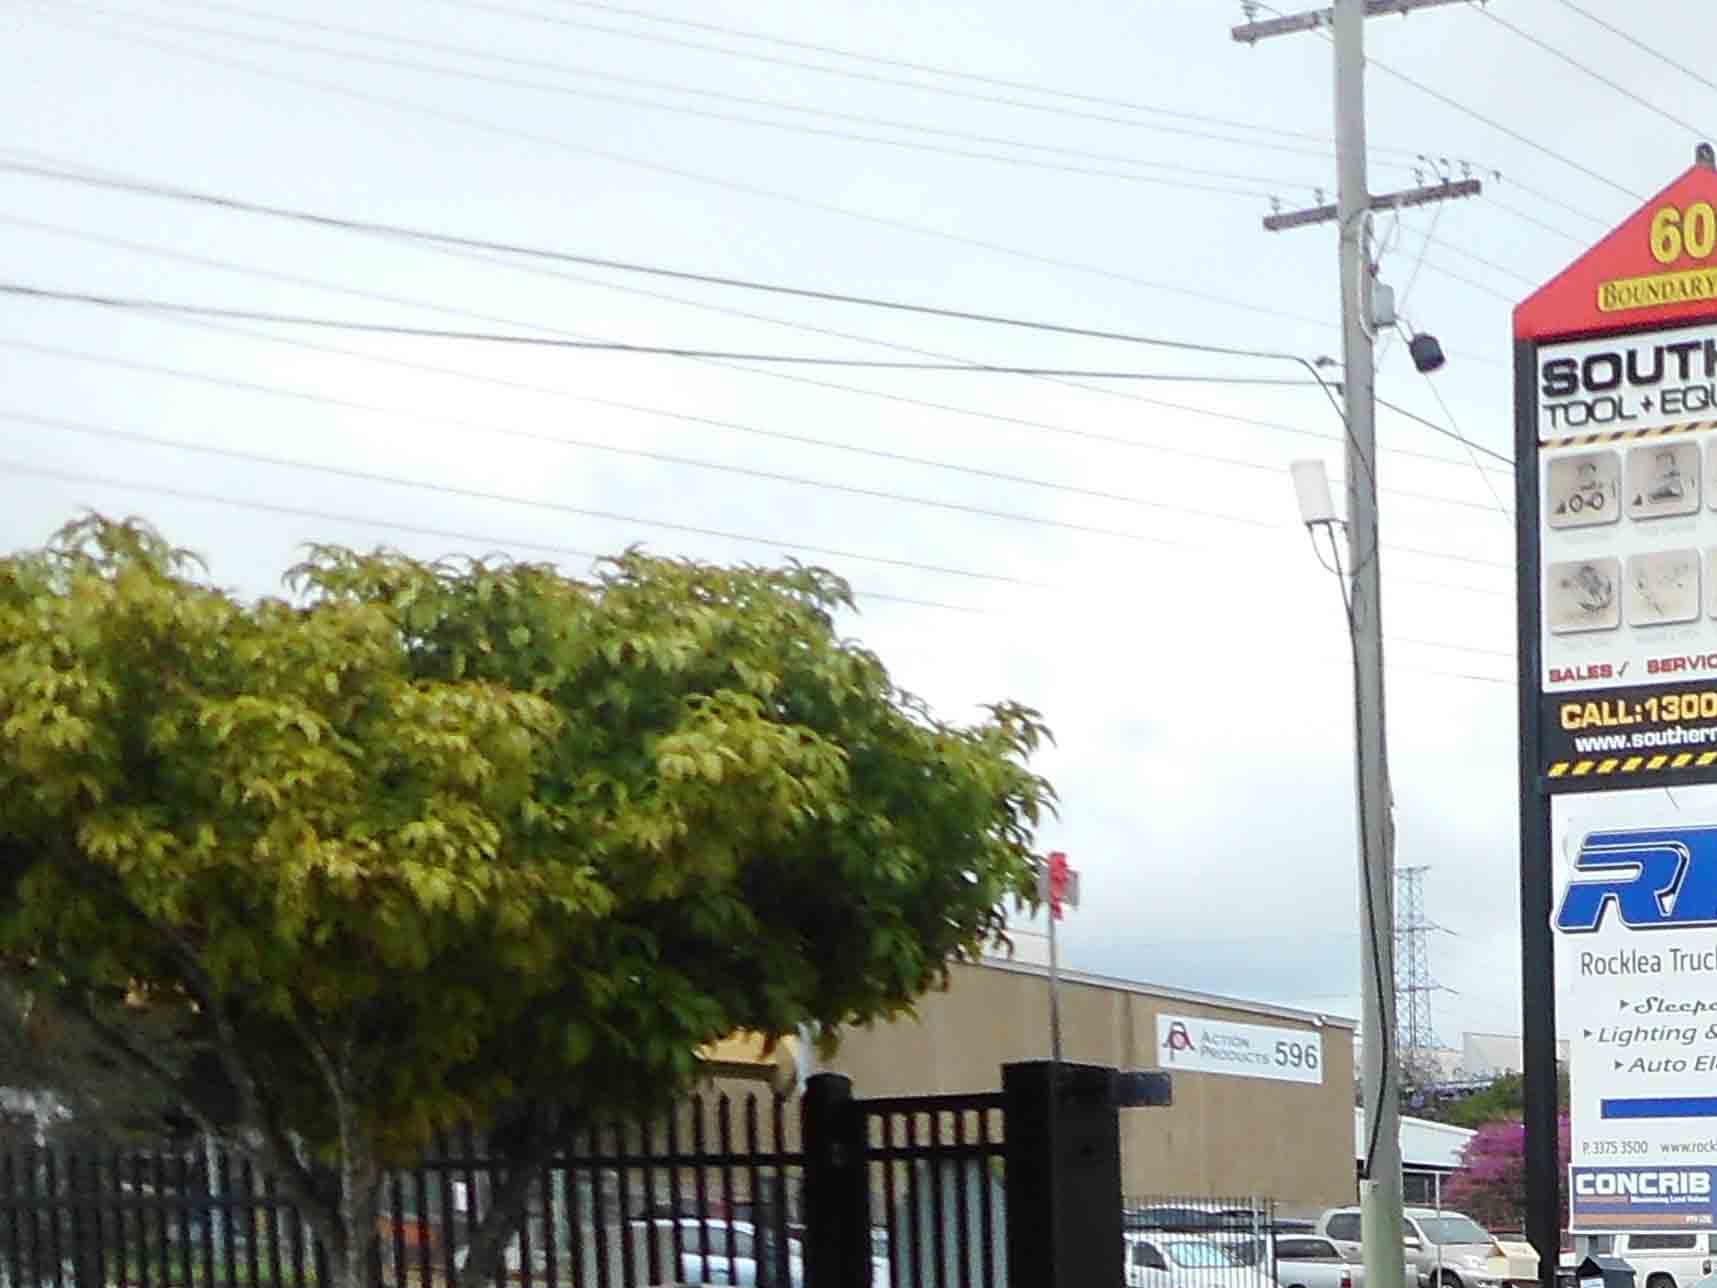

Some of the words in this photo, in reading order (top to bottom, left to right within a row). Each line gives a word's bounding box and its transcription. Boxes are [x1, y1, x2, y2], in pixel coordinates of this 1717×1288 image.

[1542, 396, 1637, 430] TOOL
[1549, 662, 1613, 684] SALES
[1580, 950, 1662, 977] Rocklea
[1597, 1026, 1697, 1047] Lighting
[1274, 1041, 1318, 1069] 596
[1627, 1056, 1688, 1073] Auto
[1619, 1139, 1649, 1155] 3500
[1575, 1172, 1711, 1195] CONCRIB
